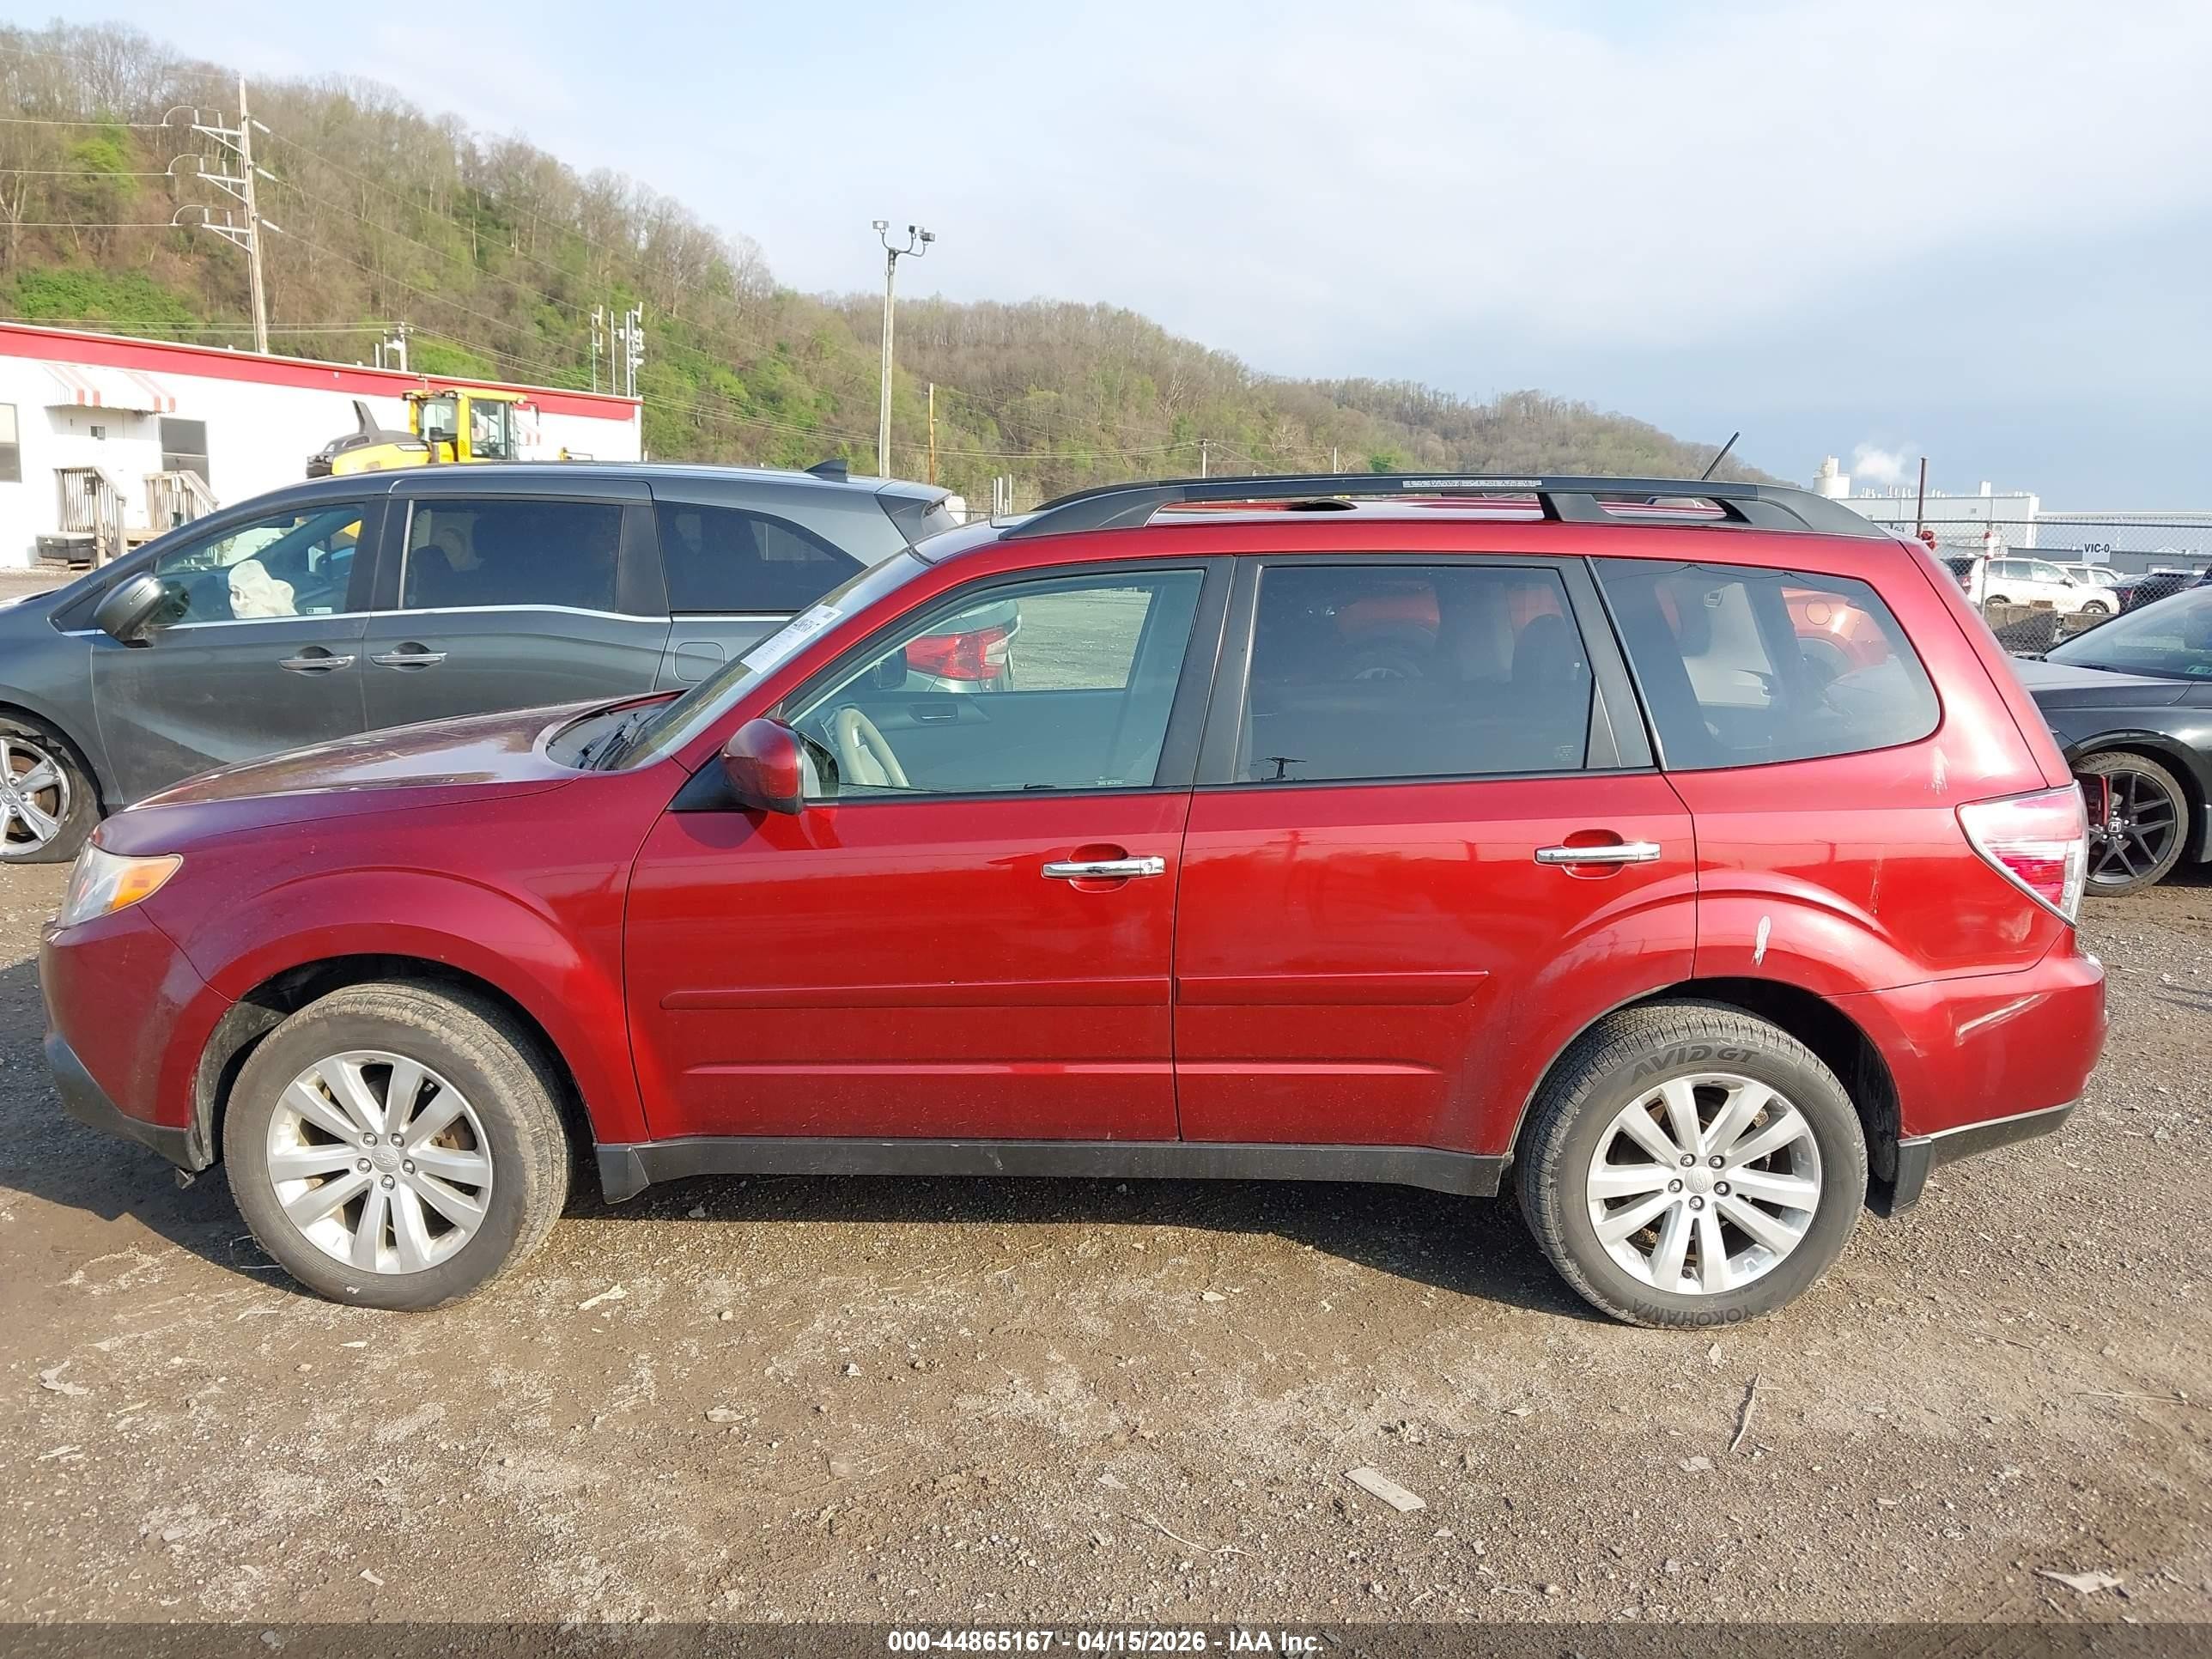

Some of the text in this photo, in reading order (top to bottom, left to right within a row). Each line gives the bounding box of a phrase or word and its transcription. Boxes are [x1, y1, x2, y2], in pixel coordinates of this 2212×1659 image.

[2084, 543, 2110, 553] VIC-0
[1632, 1044, 1759, 1085] AVID GT
[1632, 1298, 1753, 1327] YOKOHAMA
